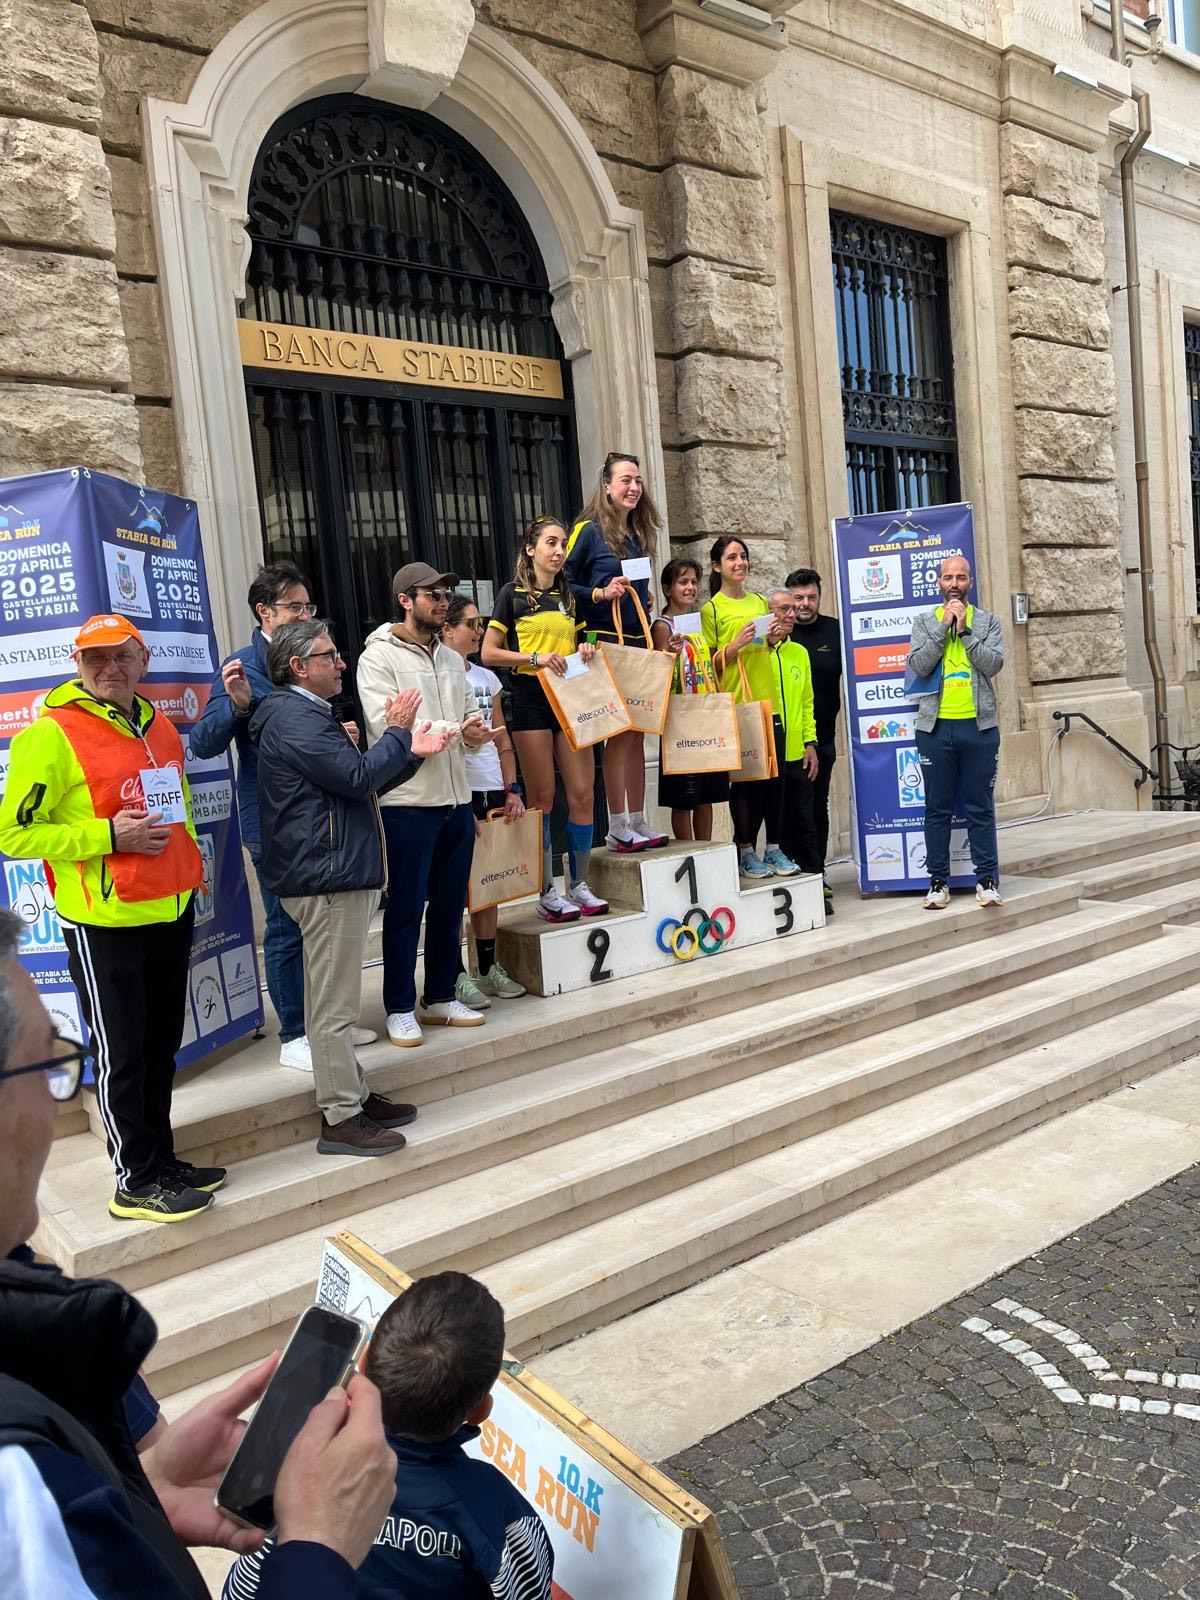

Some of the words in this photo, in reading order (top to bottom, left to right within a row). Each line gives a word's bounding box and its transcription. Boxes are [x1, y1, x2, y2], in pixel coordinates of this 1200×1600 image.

[260, 329, 384, 374] BANCA
[403, 348, 546, 391] STABIESE
[0, 530, 12, 541] EA
[15, 527, 40, 539] RUN
[116, 528, 148, 544] STABIA
[162, 538, 177, 550] RUN
[0, 541, 72, 562] DOMENICA
[868, 542, 902, 553] STABIA
[903, 541, 920, 550] SEA
[923, 538, 942, 547] RUN
[151, 555, 197, 570] DOMENICA
[910, 548, 963, 562] DOMENICA
[0, 564, 16, 576] 27
[21, 556, 73, 574] APRILE
[911, 561, 924, 570] 27
[152, 568, 164, 579] 27
[168, 570, 198, 583] APRILE
[912, 570, 938, 585] 20
[1, 572, 76, 600] 2025
[155, 583, 200, 604] 2025
[913, 590, 924, 598] DI
[927, 588, 941, 596] ST
[3, 593, 78, 609] CASTELLAMMARE
[4, 610, 20, 621] DI
[25, 601, 79, 619] STABIA
[160, 610, 172, 619] DI
[176, 610, 204, 622] STABIA
[875, 616, 913, 628] BANCA
[878, 654, 906, 664] exp
[865, 685, 905, 701] elite
[624, 697, 654, 709] port.it
[0, 706, 29, 721] ert
[577, 702, 616, 723] elitesport.it
[676, 736, 726, 749] elitesport.it
[900, 750, 919, 777] IN
[147, 791, 181, 807] STAFF
[190, 789, 230, 806] RMACIE
[901, 786, 926, 802] SU
[480, 863, 528, 886] elitesport.it
[674, 856, 698, 904] 1
[772, 887, 794, 935] 3
[587, 928, 614, 982] 2
[478, 1416, 528, 1493] SEA
[534, 1465, 600, 1553] RUN
[373, 1516, 461, 1560] APOLI
